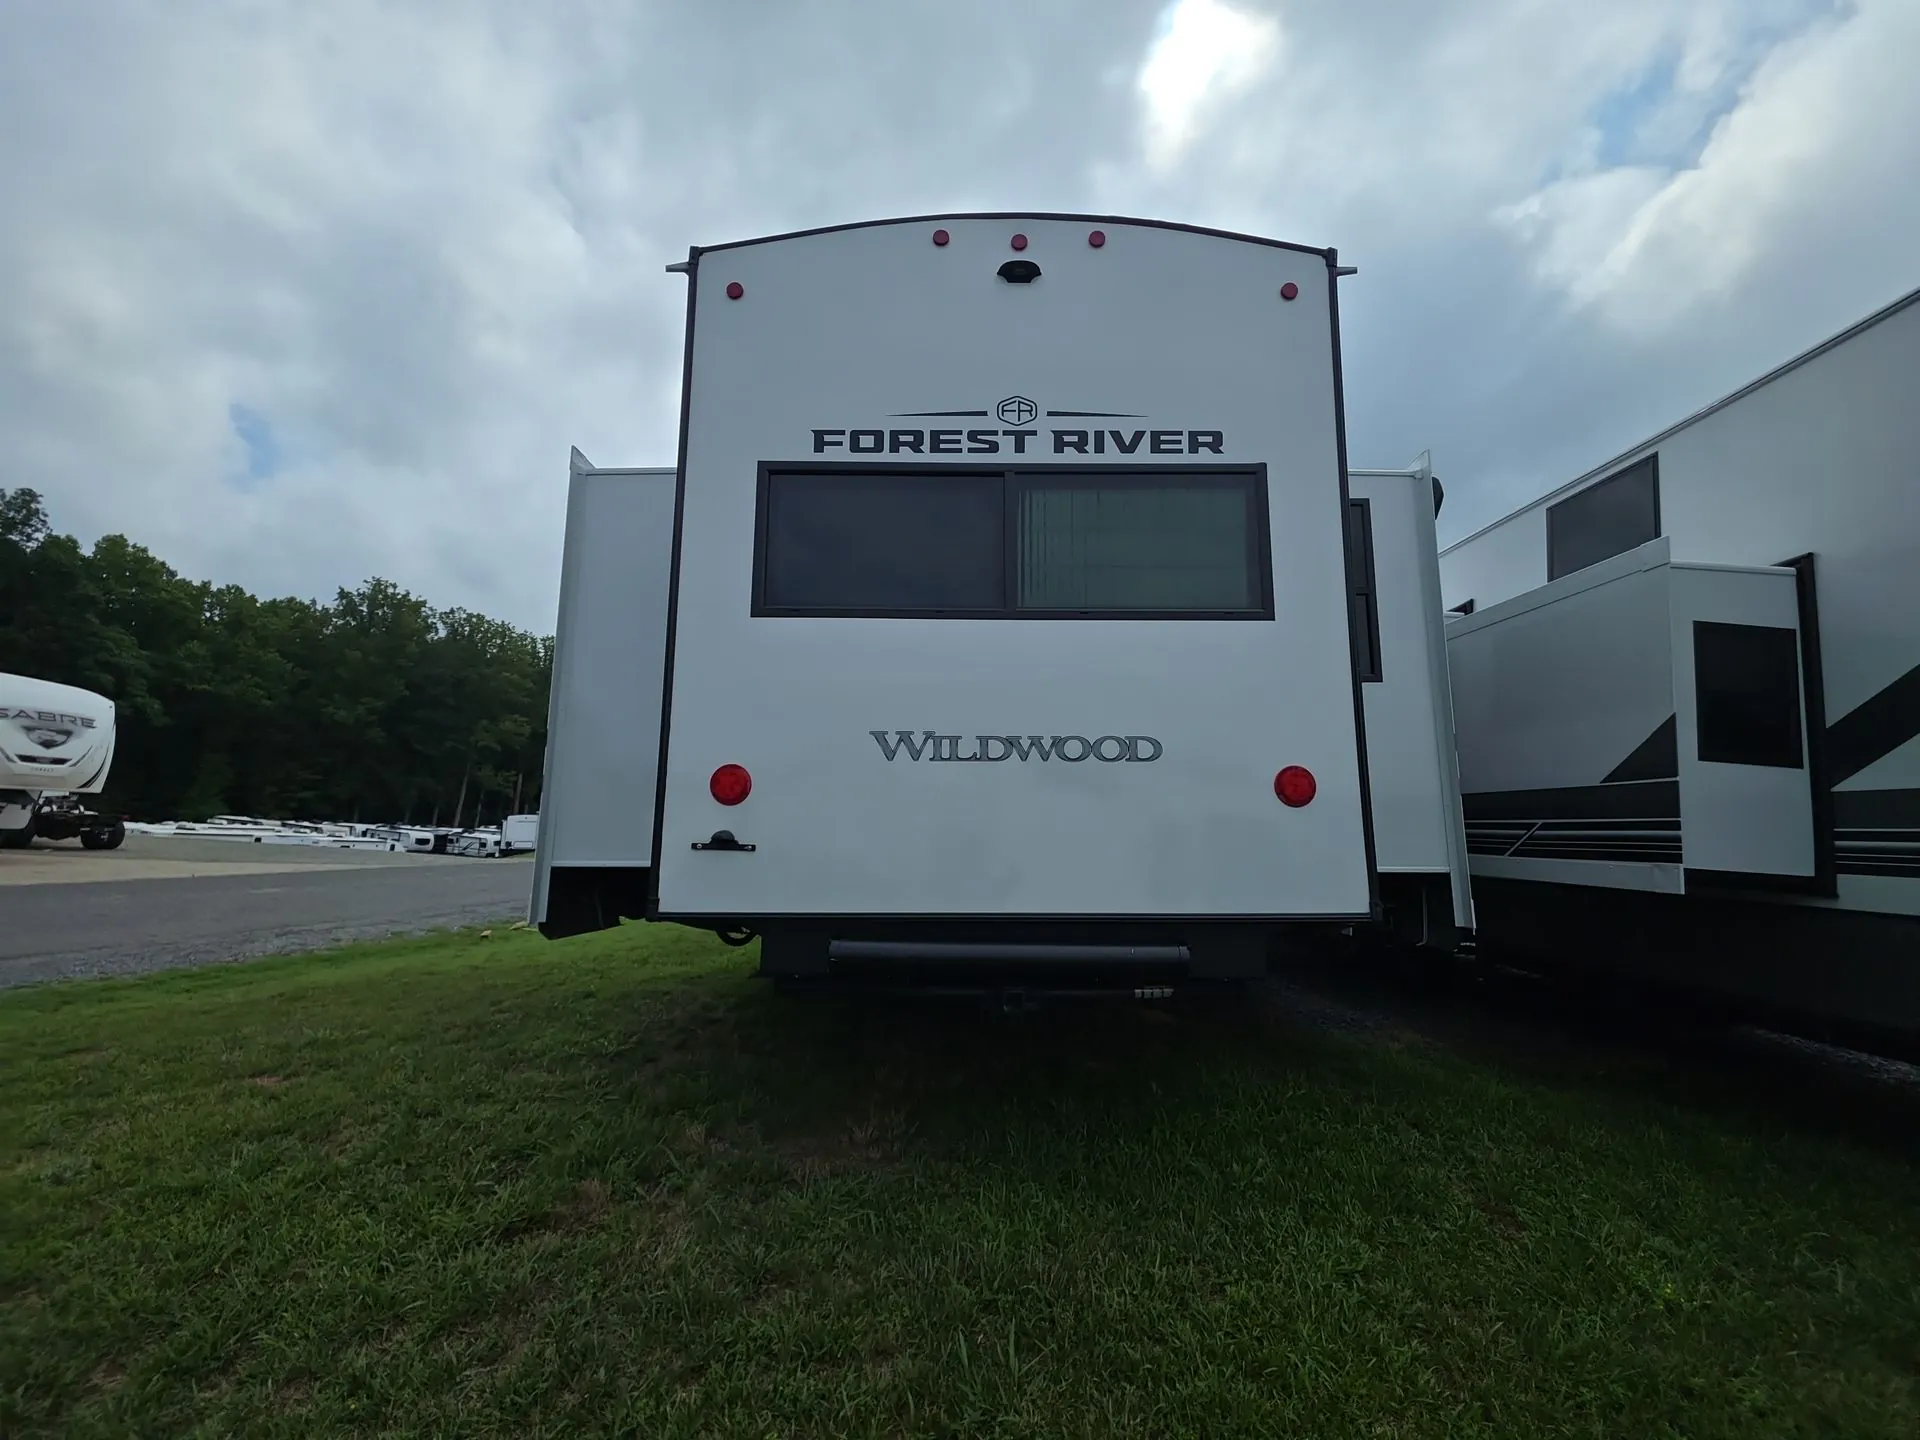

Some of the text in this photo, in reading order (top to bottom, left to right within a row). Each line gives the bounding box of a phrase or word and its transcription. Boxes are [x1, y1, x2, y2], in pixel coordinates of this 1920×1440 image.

[1001, 400, 1033, 422] FR
[810, 429, 1225, 455] FOREST RIVER
[869, 730, 1163, 762] WILDWOOD
